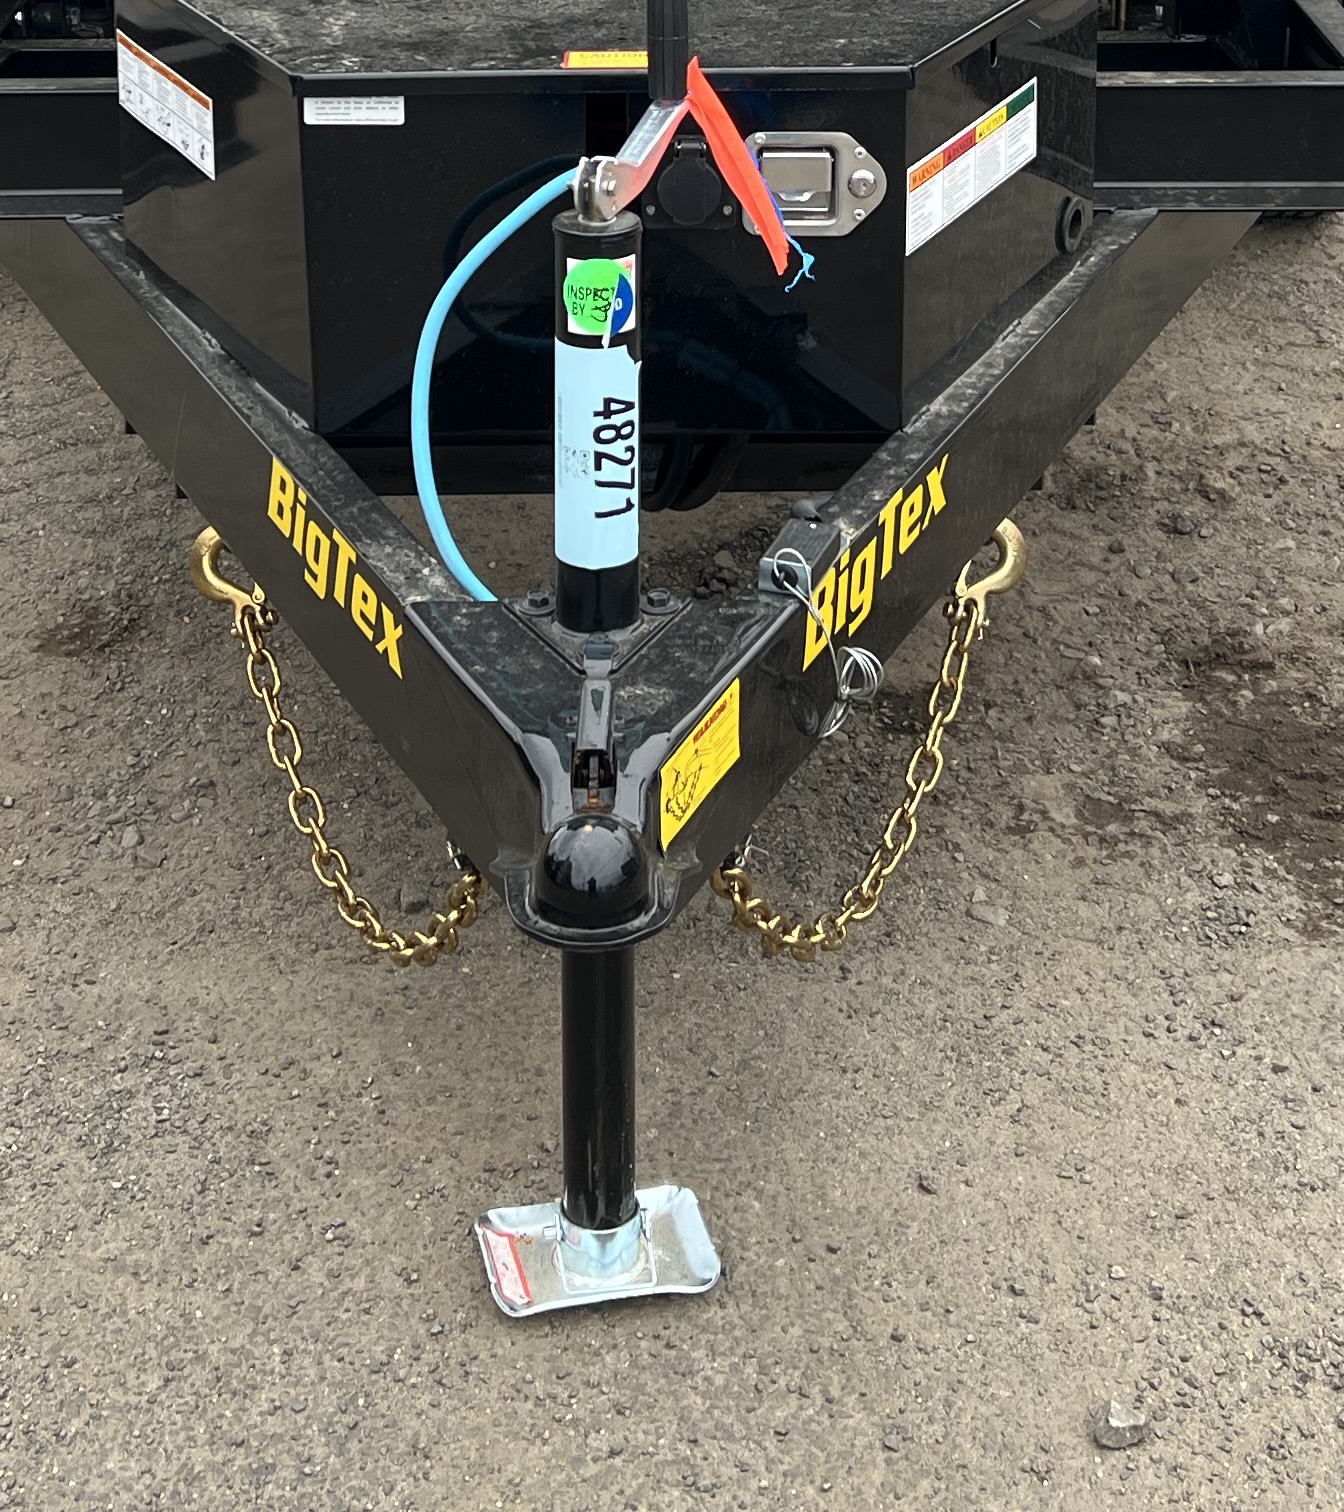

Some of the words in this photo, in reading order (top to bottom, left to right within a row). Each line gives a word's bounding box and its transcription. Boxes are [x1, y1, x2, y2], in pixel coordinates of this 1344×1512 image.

[572, 302, 585, 316] BY
[593, 396, 636, 519] 48271
[267, 456, 403, 680] BigTex
[803, 453, 949, 672] BigTex
